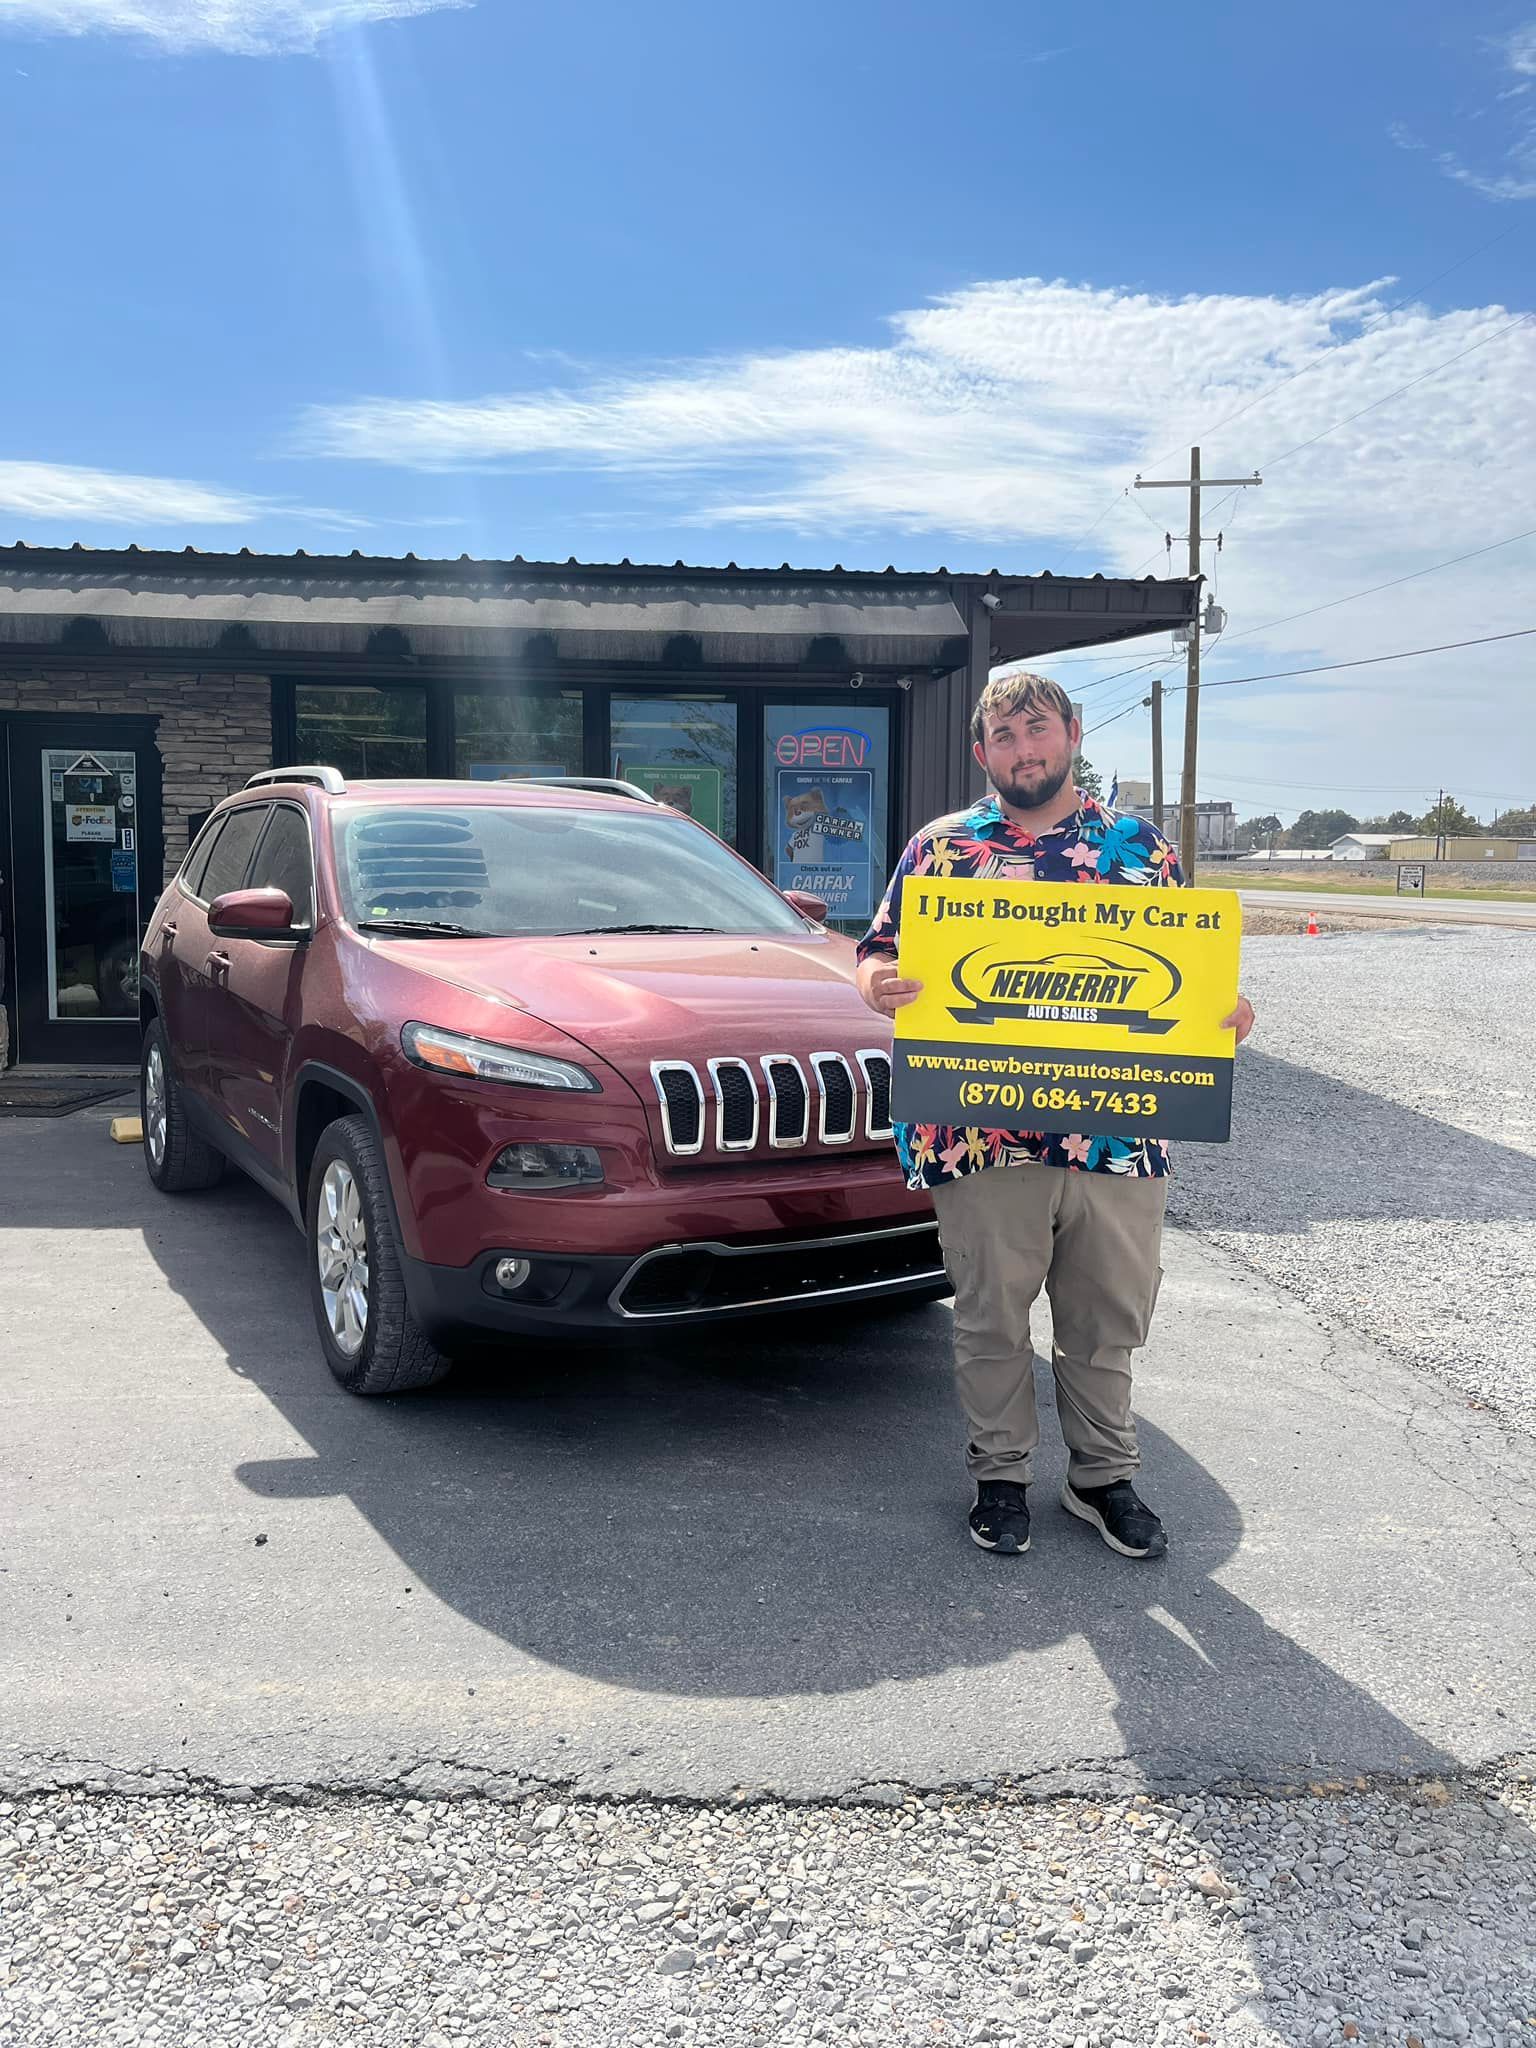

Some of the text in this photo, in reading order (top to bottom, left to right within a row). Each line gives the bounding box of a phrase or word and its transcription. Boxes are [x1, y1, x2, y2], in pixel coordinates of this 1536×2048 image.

[776, 734, 865, 767] OPEN
[86, 815, 113, 825] FedEx
[816, 814, 864, 833] CARFAX
[791, 875, 856, 890] CARFAX
[814, 892, 849, 903] WNER
[918, 895, 1221, 931] I Just Bought My Car at
[989, 968, 1138, 1005] NEWBERRY
[1027, 1004, 1098, 1022] AUTO SALES
[906, 1053, 1216, 1087] www.newberryautosales.com
[958, 1080, 1158, 1116] (870) 684-7433
